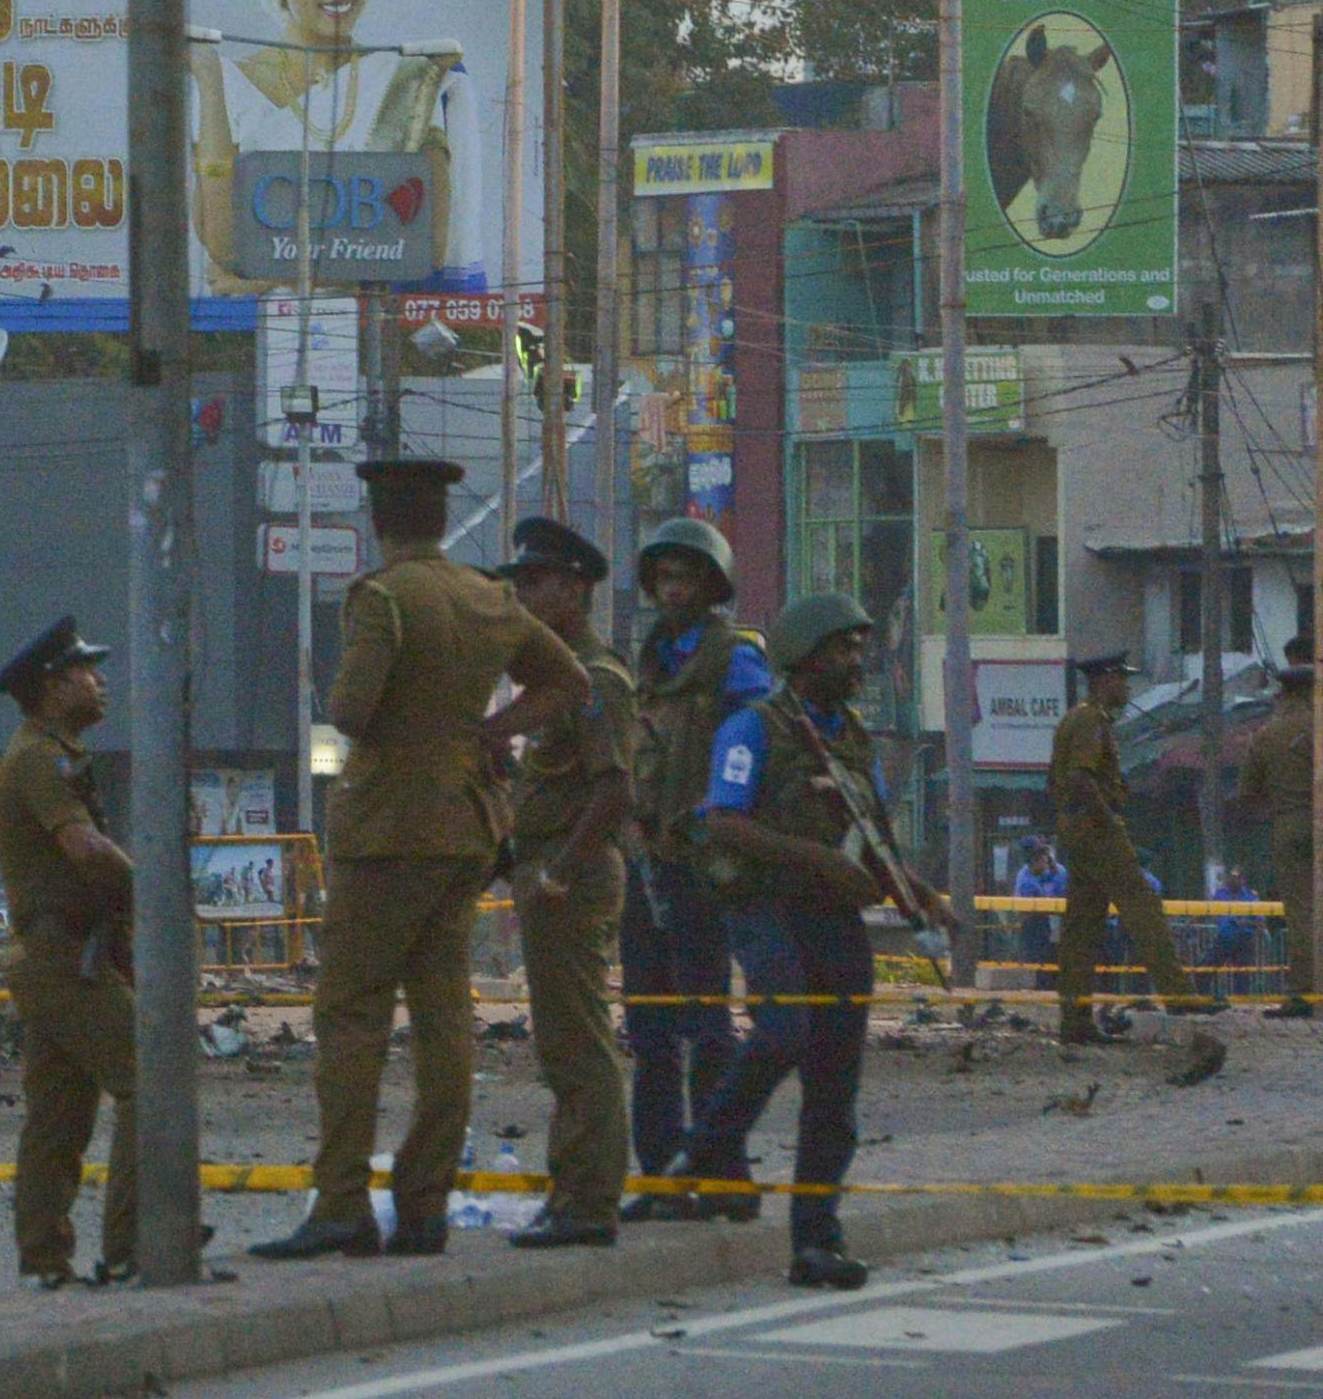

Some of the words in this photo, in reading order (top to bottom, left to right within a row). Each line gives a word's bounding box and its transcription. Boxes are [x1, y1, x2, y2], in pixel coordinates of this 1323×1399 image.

[253, 174, 385, 230] CDB
[272, 236, 326, 259] Yor
[330, 237, 405, 260] Friend
[964, 267, 1009, 282] usted
[1013, 267, 1035, 282] for
[1039, 267, 1136, 282] Generations
[1140, 267, 1170, 282] and
[1014, 288, 1105, 303] Unmatched
[1032, 697, 1059, 717] CAFE
